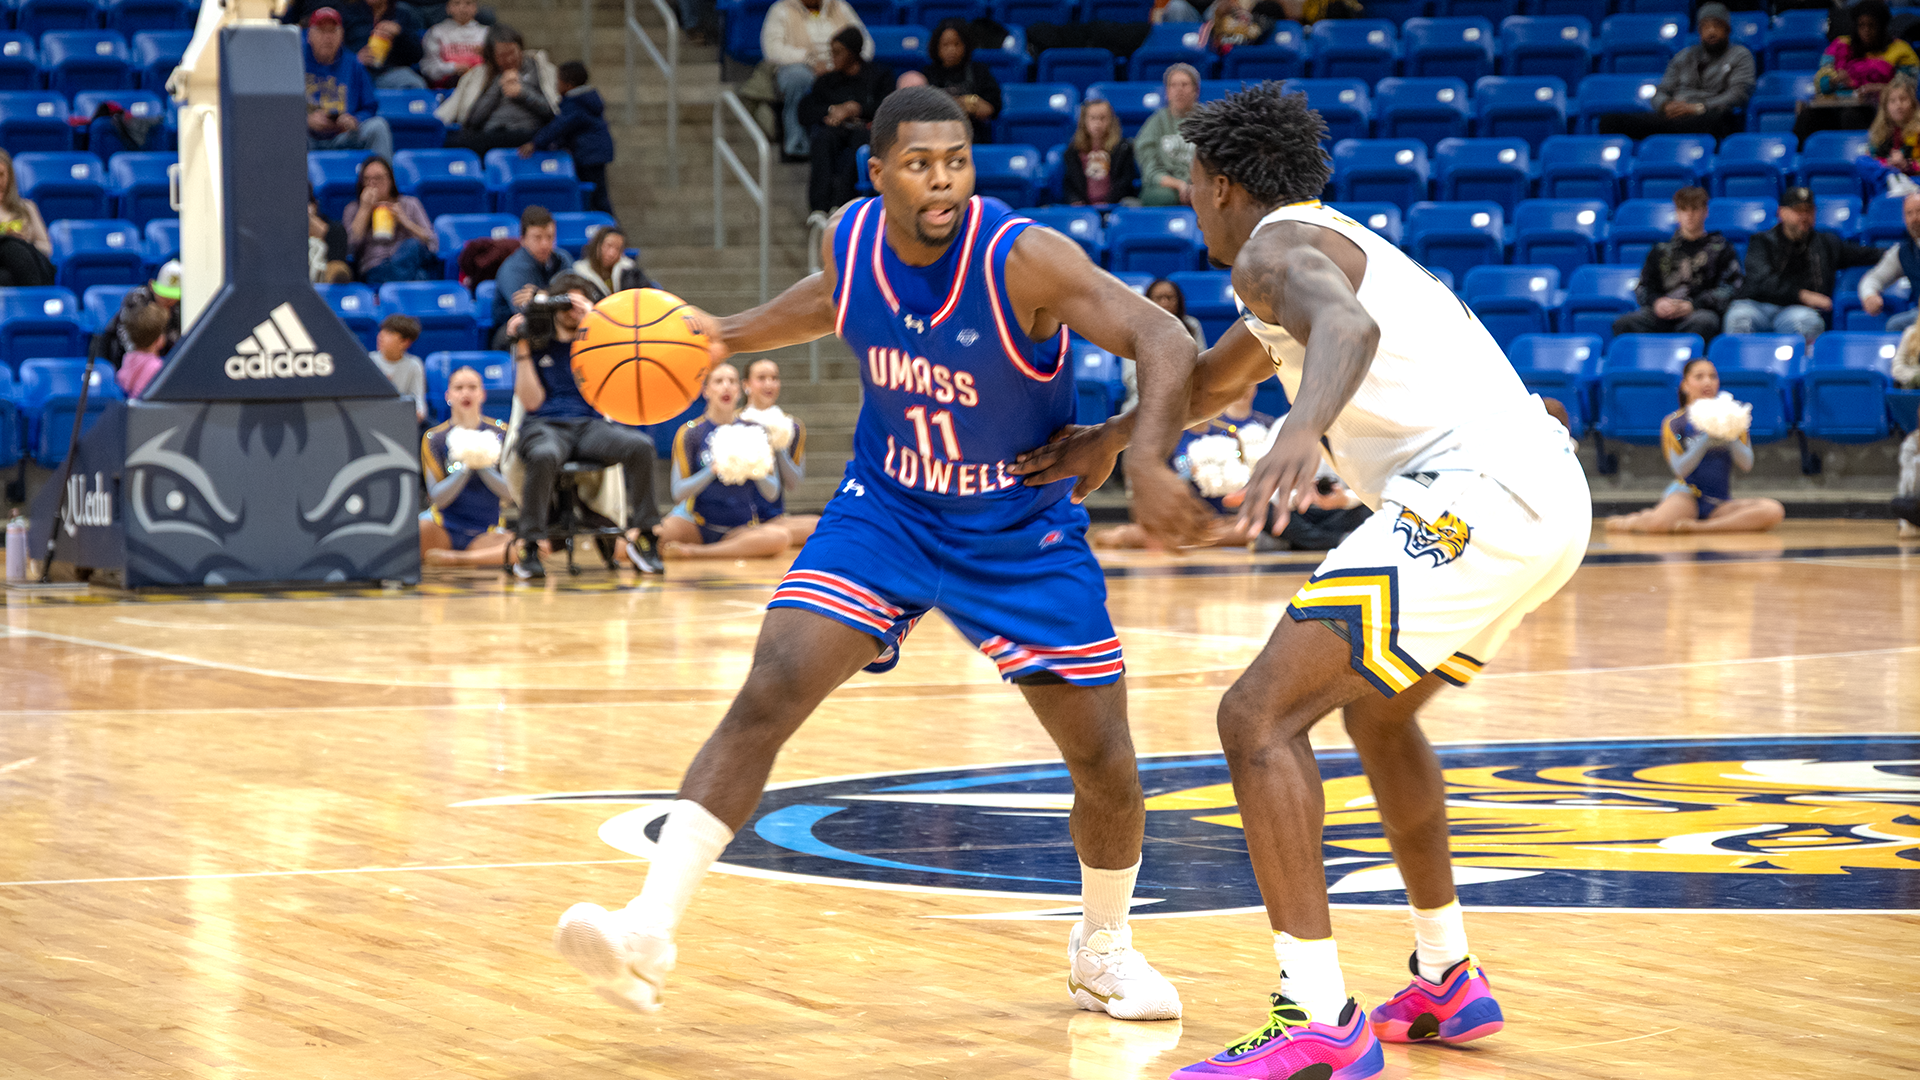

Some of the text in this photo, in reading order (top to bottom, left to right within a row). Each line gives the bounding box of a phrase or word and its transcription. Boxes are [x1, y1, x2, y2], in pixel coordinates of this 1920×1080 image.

[224, 350, 334, 380] adidas
[867, 346, 979, 408] UMASS
[904, 404, 963, 462] 11
[884, 434, 1017, 497] LOWELL
